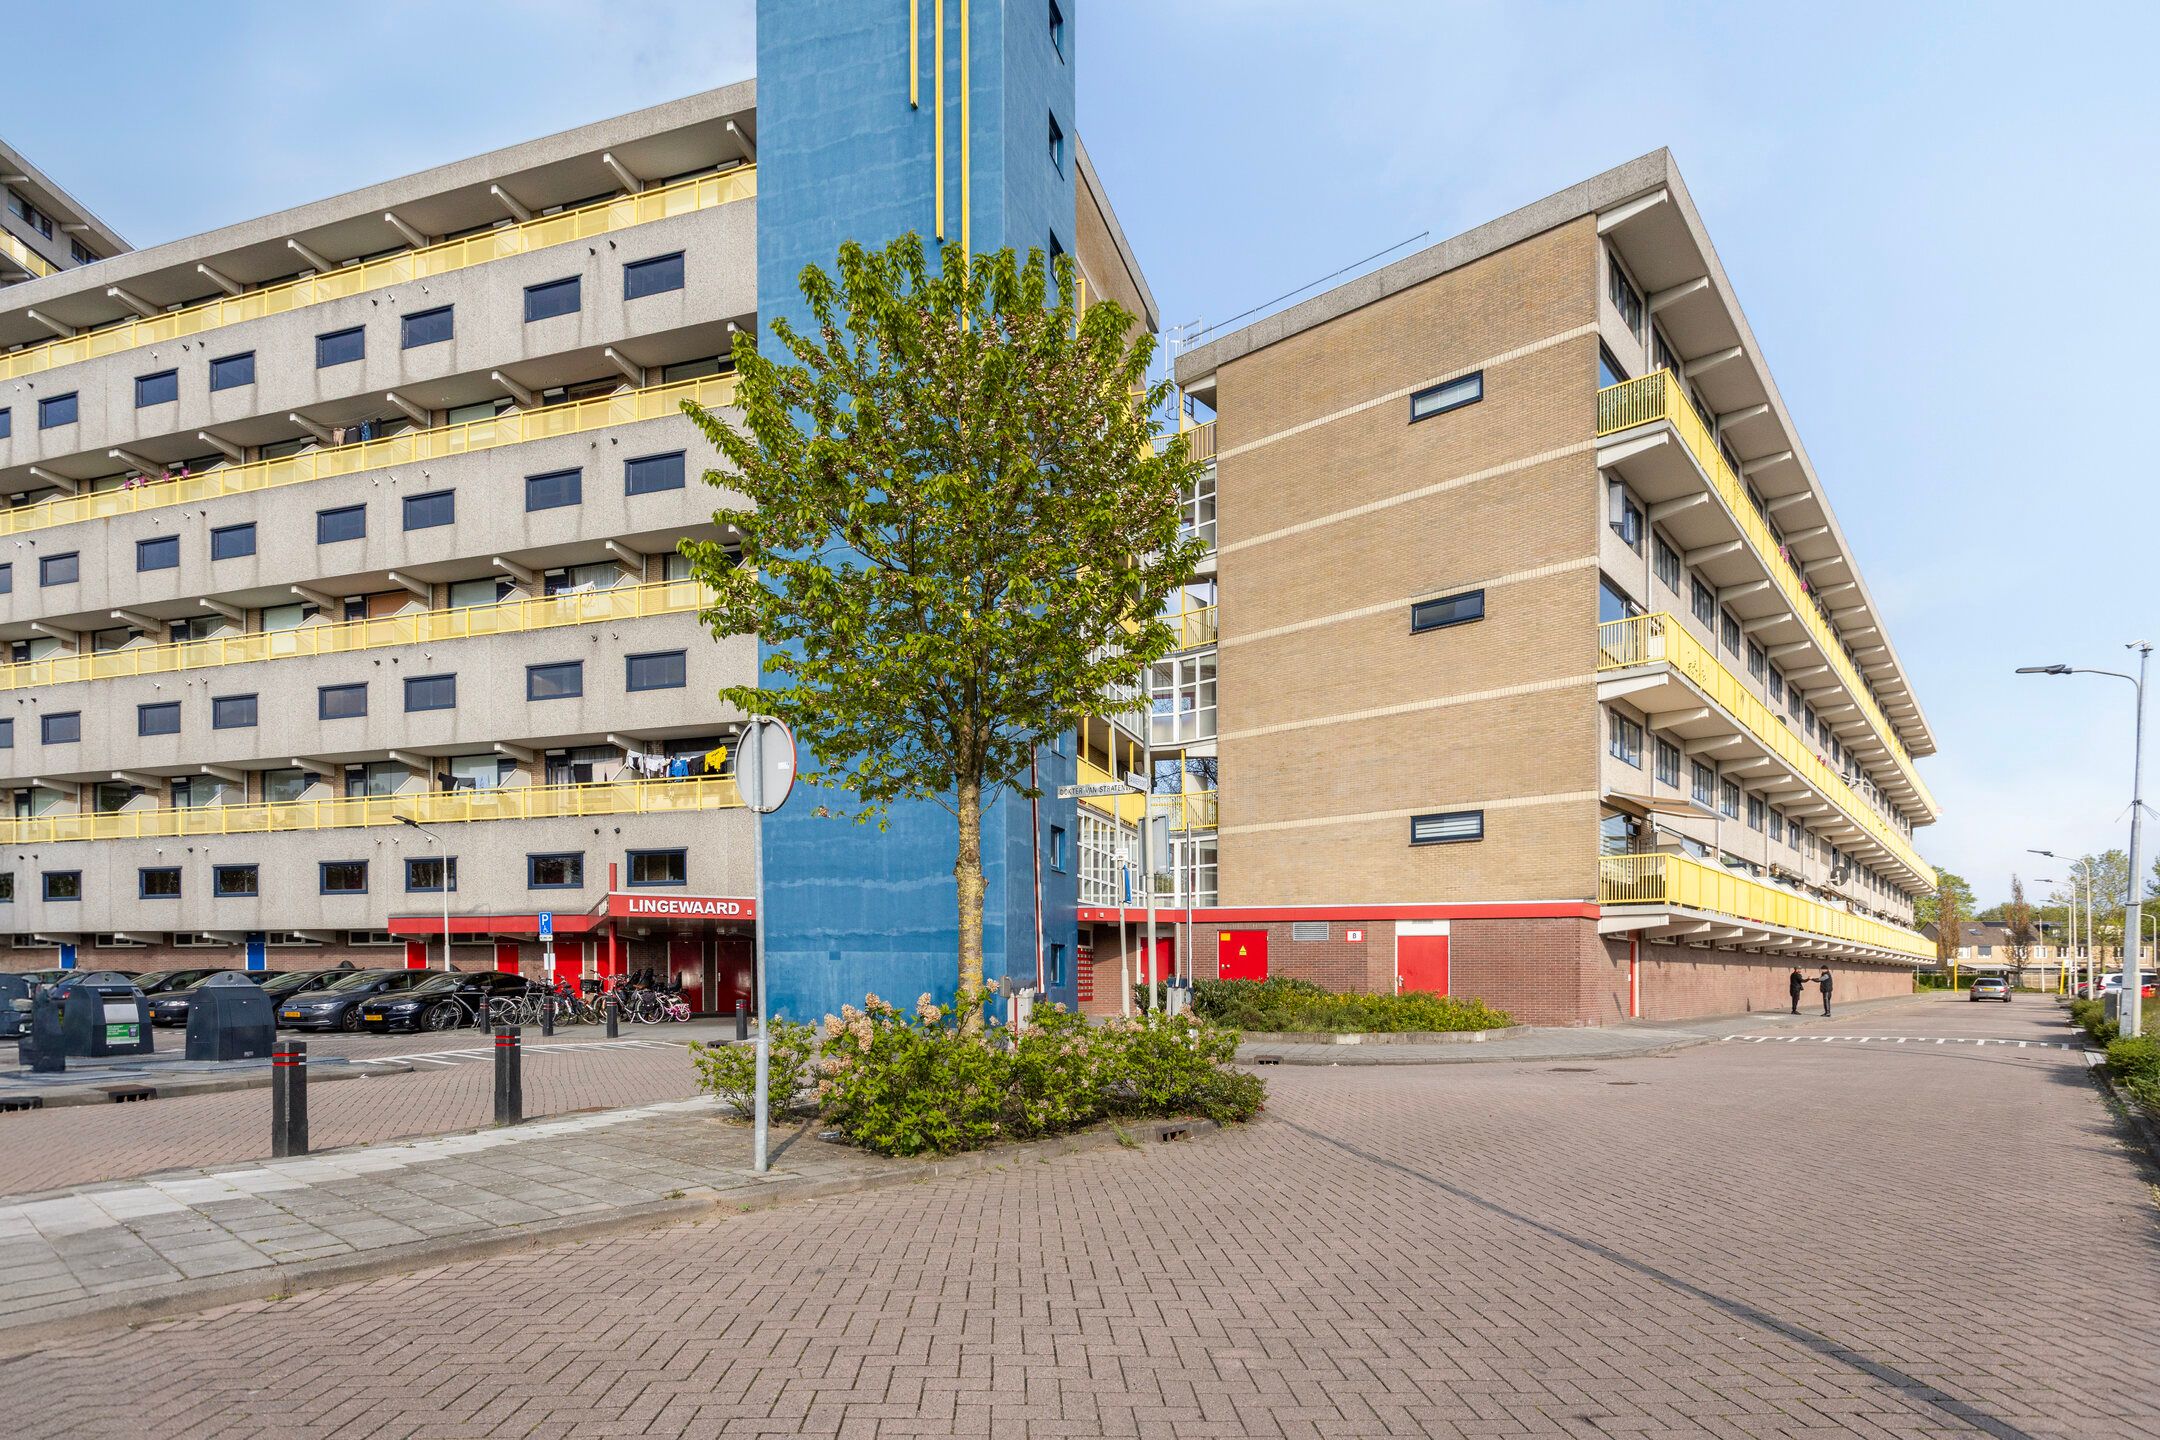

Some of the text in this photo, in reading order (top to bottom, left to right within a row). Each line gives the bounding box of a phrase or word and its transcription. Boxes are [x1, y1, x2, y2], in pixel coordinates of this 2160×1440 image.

[1086, 786, 1097, 794] VAN
[629, 899, 740, 915] LINGEWAARD
[541, 914, 549, 926] P
